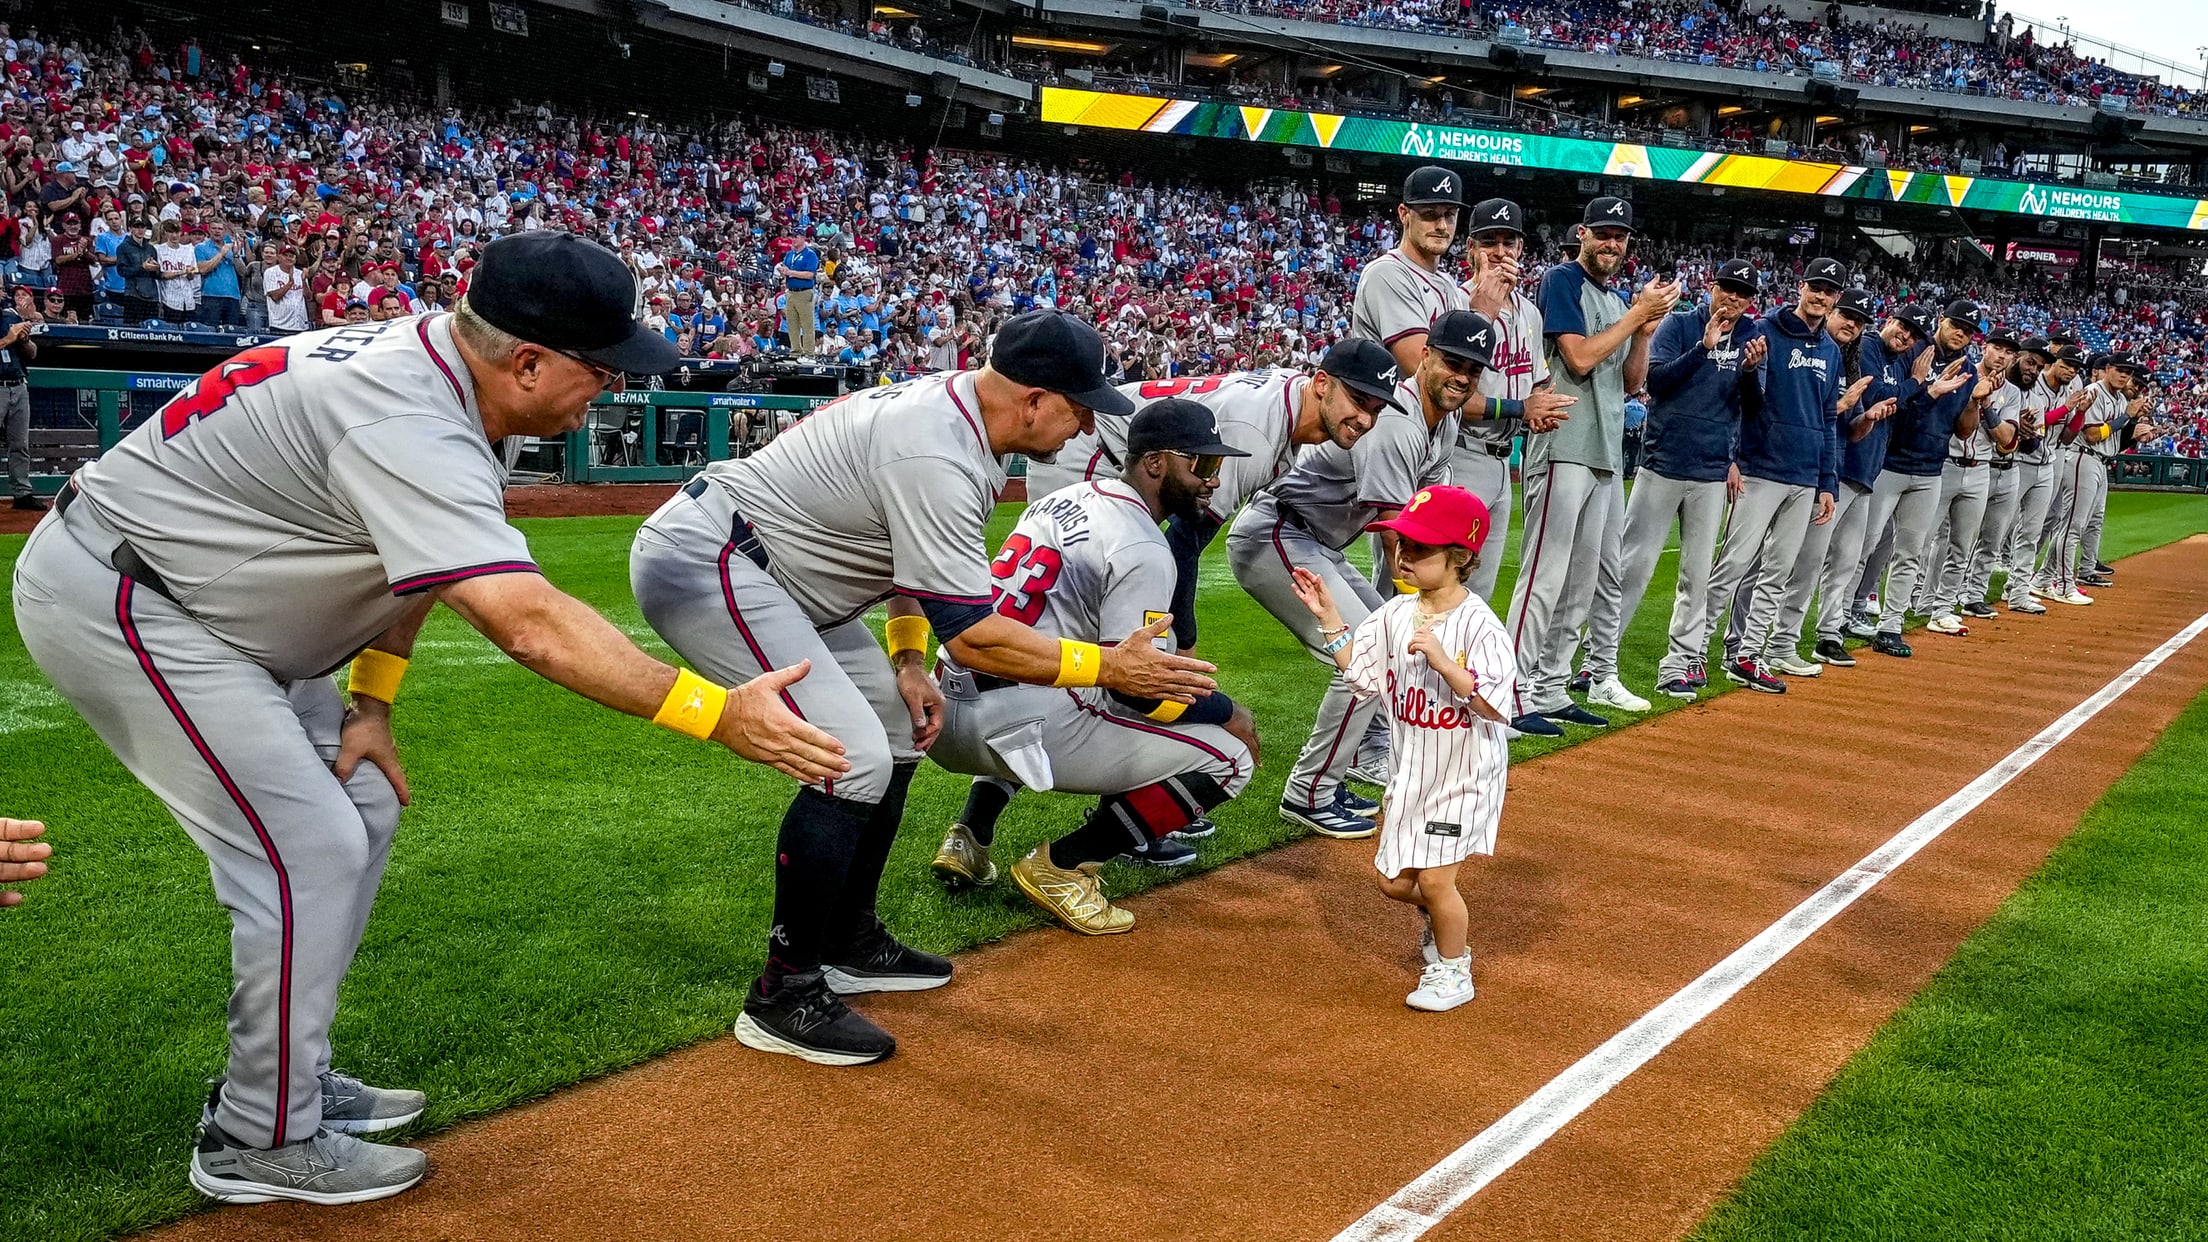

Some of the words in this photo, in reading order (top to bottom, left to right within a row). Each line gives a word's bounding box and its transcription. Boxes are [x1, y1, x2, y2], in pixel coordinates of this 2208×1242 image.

[1440, 132, 1522, 152] NEMOURS
[1439, 148, 1488, 163] CHILDREN'S
[1432, 176, 1452, 193] A
[1606, 201, 1624, 216] A
[2051, 191, 2121, 210] NEMOURS
[1491, 205, 1510, 221] A
[2050, 207, 2092, 219] CHILDREN'S
[2016, 250, 2056, 262] CORNER
[1821, 263, 1837, 276] A
[120, 331, 149, 340] Citizens
[150, 333, 167, 341] Bank
[168, 334, 184, 342] Park
[1466, 328, 1488, 348] A
[1493, 341, 1532, 370] tlanta
[136, 376, 193, 389] smartwa
[1377, 364, 1398, 386] A
[160, 346, 290, 442] 4
[613, 392, 650, 404] RE/MAX
[712, 396, 752, 406] smartwater
[809, 398, 836, 409] RE/M
[1408, 490, 1432, 513] P
[1024, 497, 1089, 532] HARRIS
[1062, 529, 1090, 547] II
[990, 532, 1064, 628] 23
[1385, 668, 1473, 730] Phillies
